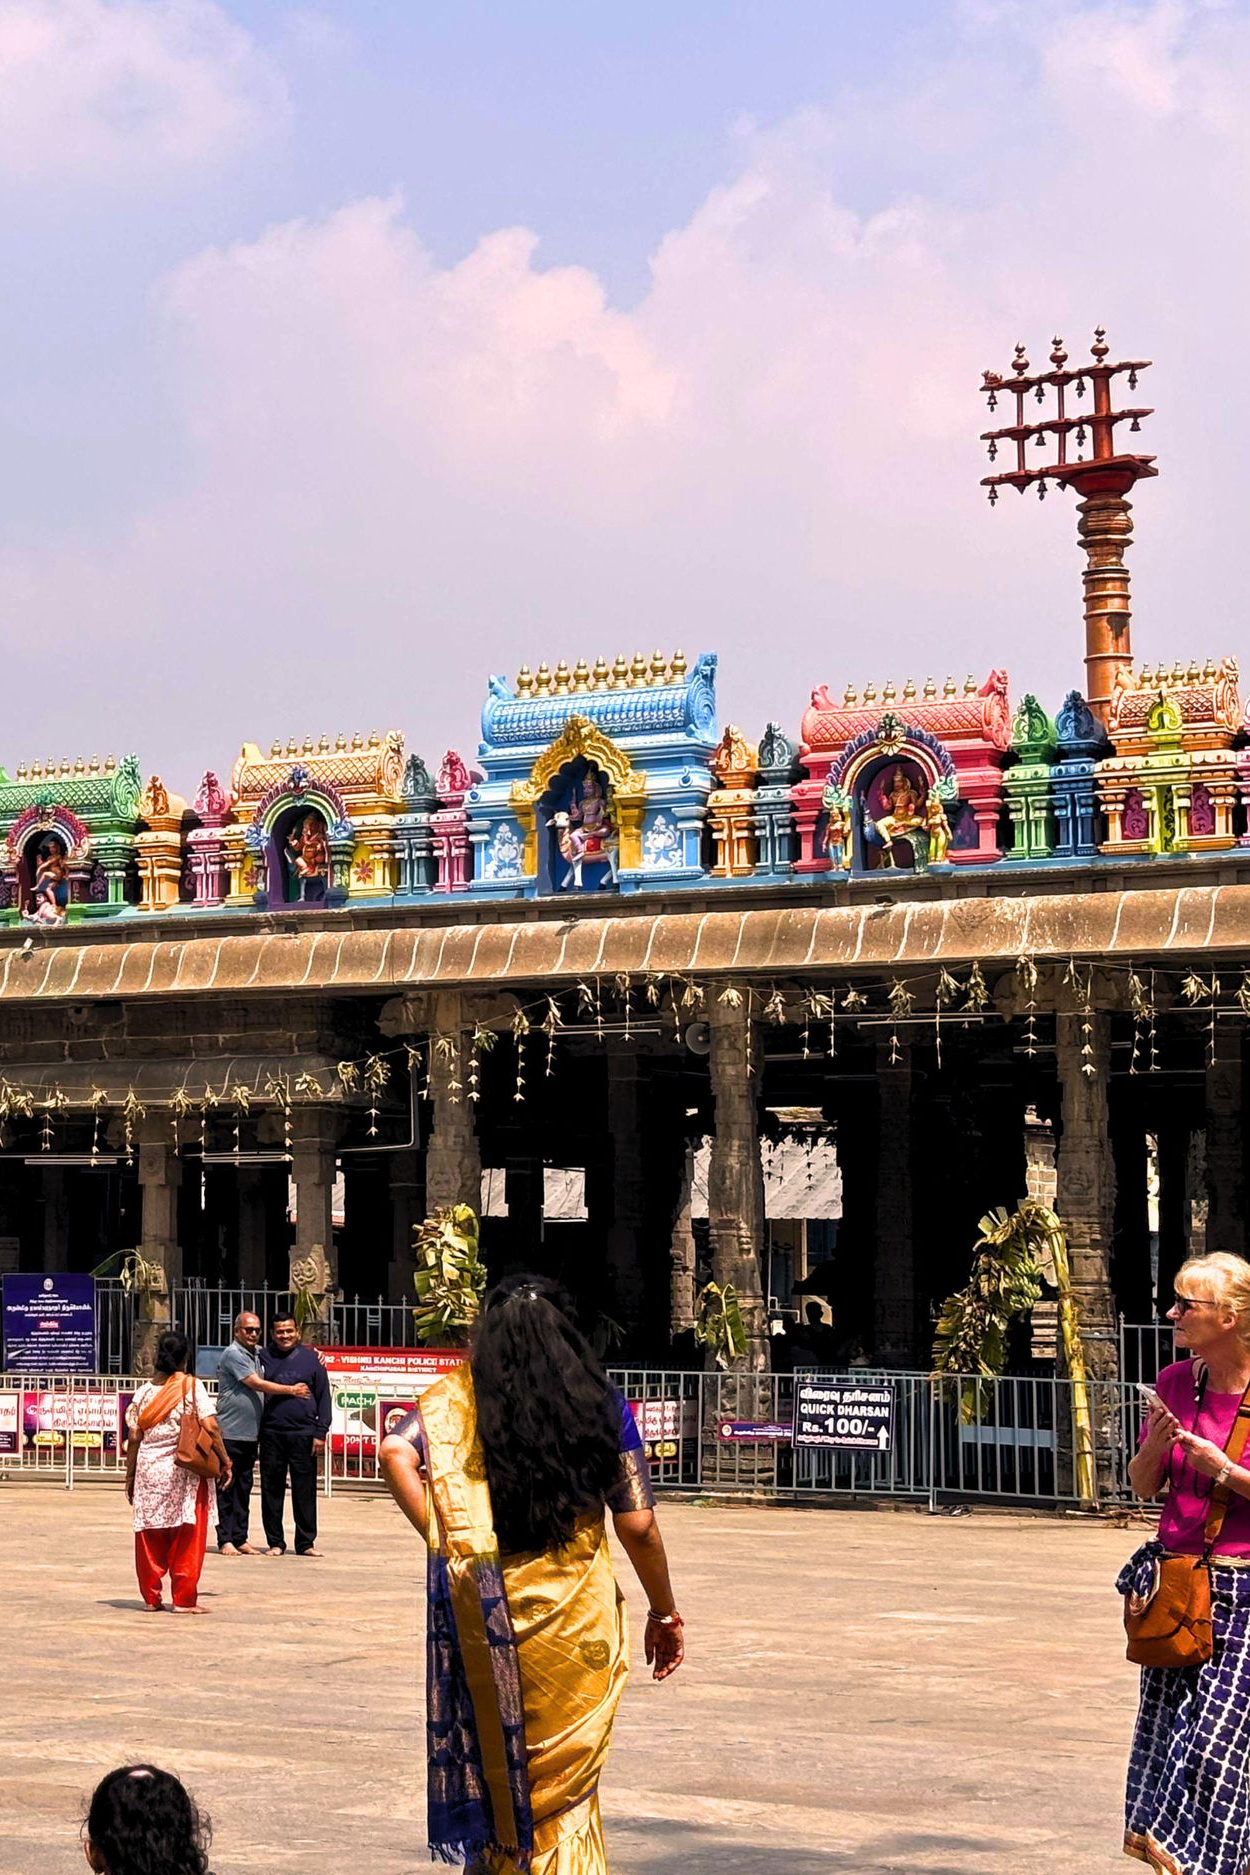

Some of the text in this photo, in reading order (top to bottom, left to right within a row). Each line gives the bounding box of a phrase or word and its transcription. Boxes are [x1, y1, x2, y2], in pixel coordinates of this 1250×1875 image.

[374, 1357, 406, 1365] KANCHI
[408, 1357, 437, 1365] POLICE
[800, 1387, 891, 1404] விரைவு தரிசனம்
[800, 1402, 889, 1418] QUICK DHARSAN
